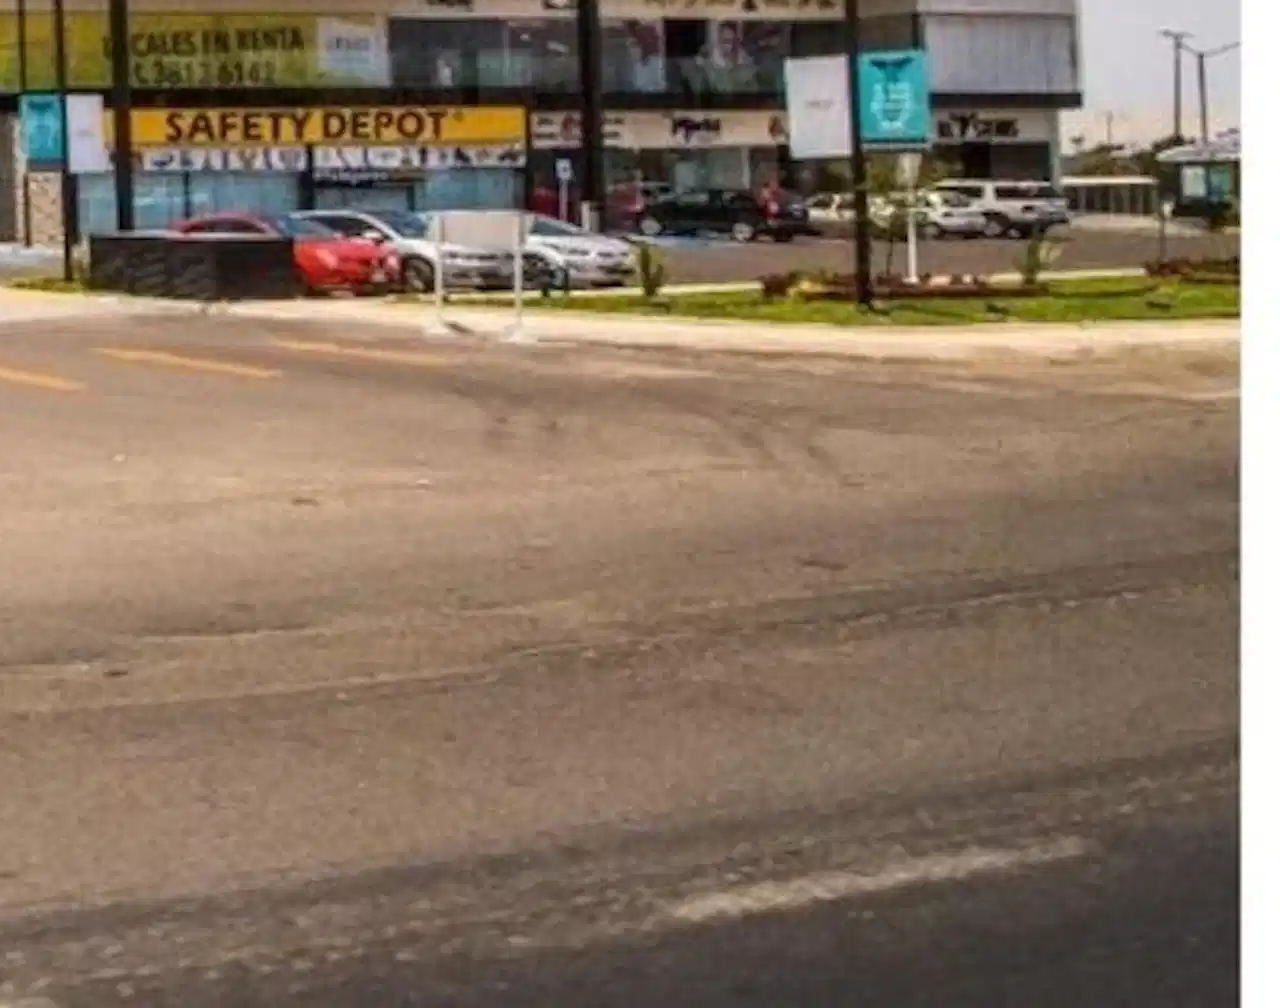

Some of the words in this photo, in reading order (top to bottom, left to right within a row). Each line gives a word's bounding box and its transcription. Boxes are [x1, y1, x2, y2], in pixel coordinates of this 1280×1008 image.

[235, 25, 305, 52] RENTA
[164, 110, 313, 142] SAFETY
[323, 109, 447, 140] DEPOT
